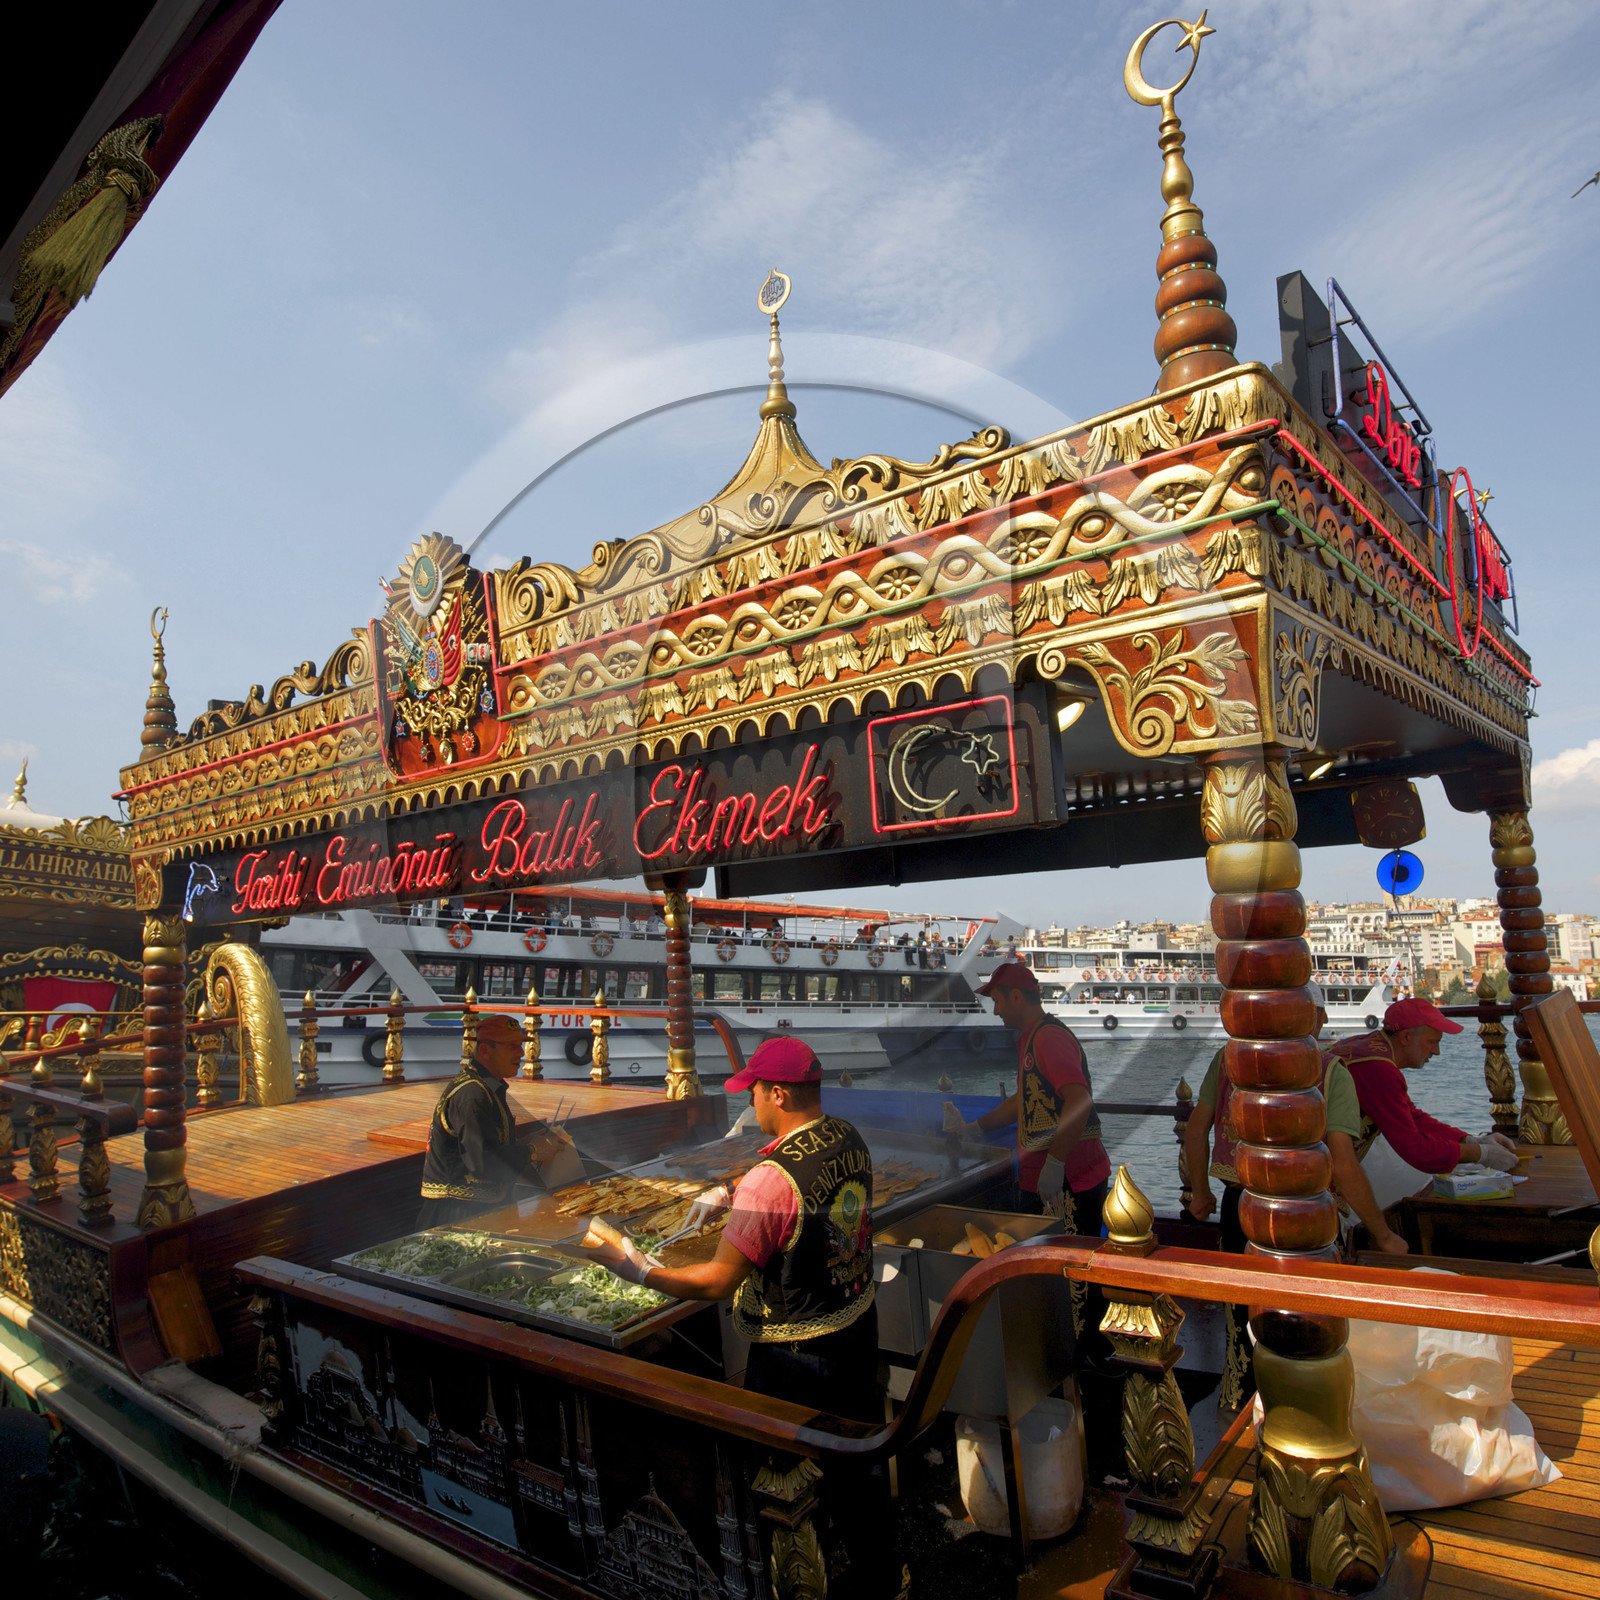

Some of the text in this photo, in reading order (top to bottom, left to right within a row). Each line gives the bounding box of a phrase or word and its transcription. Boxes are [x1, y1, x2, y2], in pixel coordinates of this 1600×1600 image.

[231, 850, 308, 914] Tarihi
[317, 833, 457, 904] Eminönü
[634, 744, 829, 860] Ekmek
[549, 1014, 622, 1028] TURL
